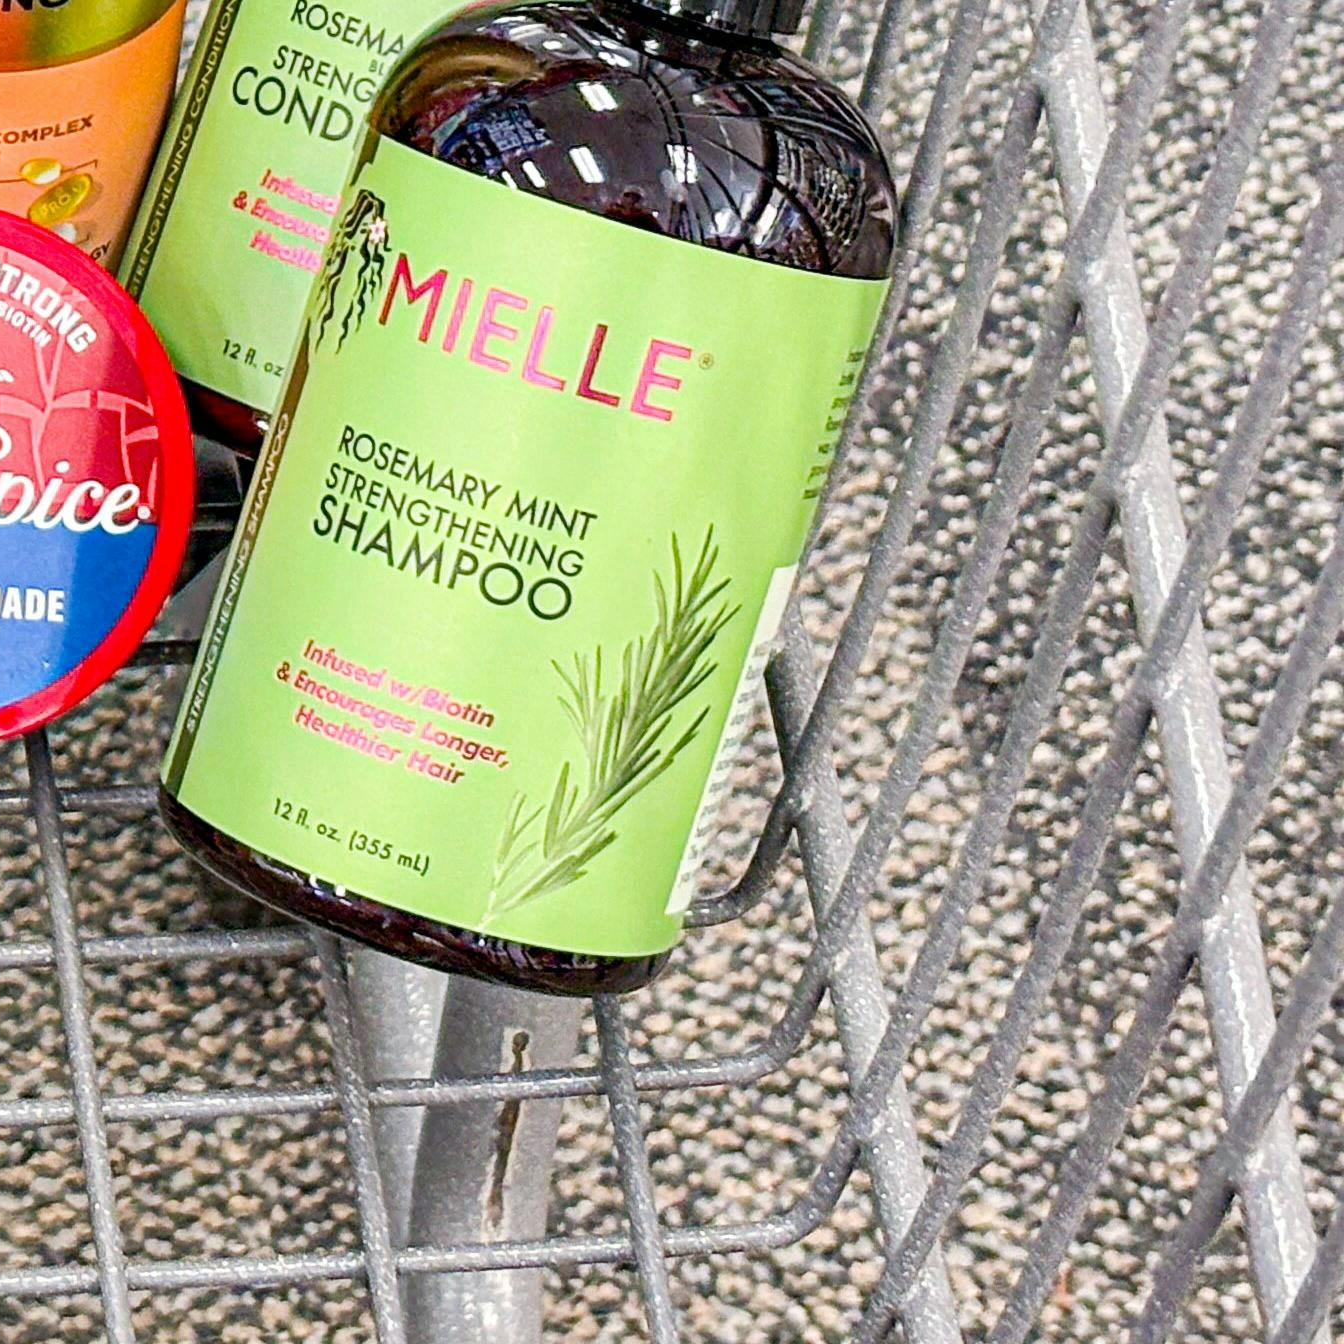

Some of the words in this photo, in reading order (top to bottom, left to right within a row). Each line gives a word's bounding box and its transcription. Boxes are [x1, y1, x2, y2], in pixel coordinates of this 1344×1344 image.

[378, 252, 693, 422] MIELLE
[325, 461, 585, 578] STRENGTHENING
[337, 425, 502, 511] ROSEMARY
[506, 490, 598, 542] MINT
[313, 493, 573, 621] SHAMPOO
[293, 670, 416, 736] Encourages
[421, 722, 510, 768] Longer,
[303, 640, 387, 688] Infused
[390, 680, 495, 728] w/Biotin
[294, 704, 401, 763] Healthier
[407, 749, 465, 784] Hair
[397, 854, 431, 877] mL)
